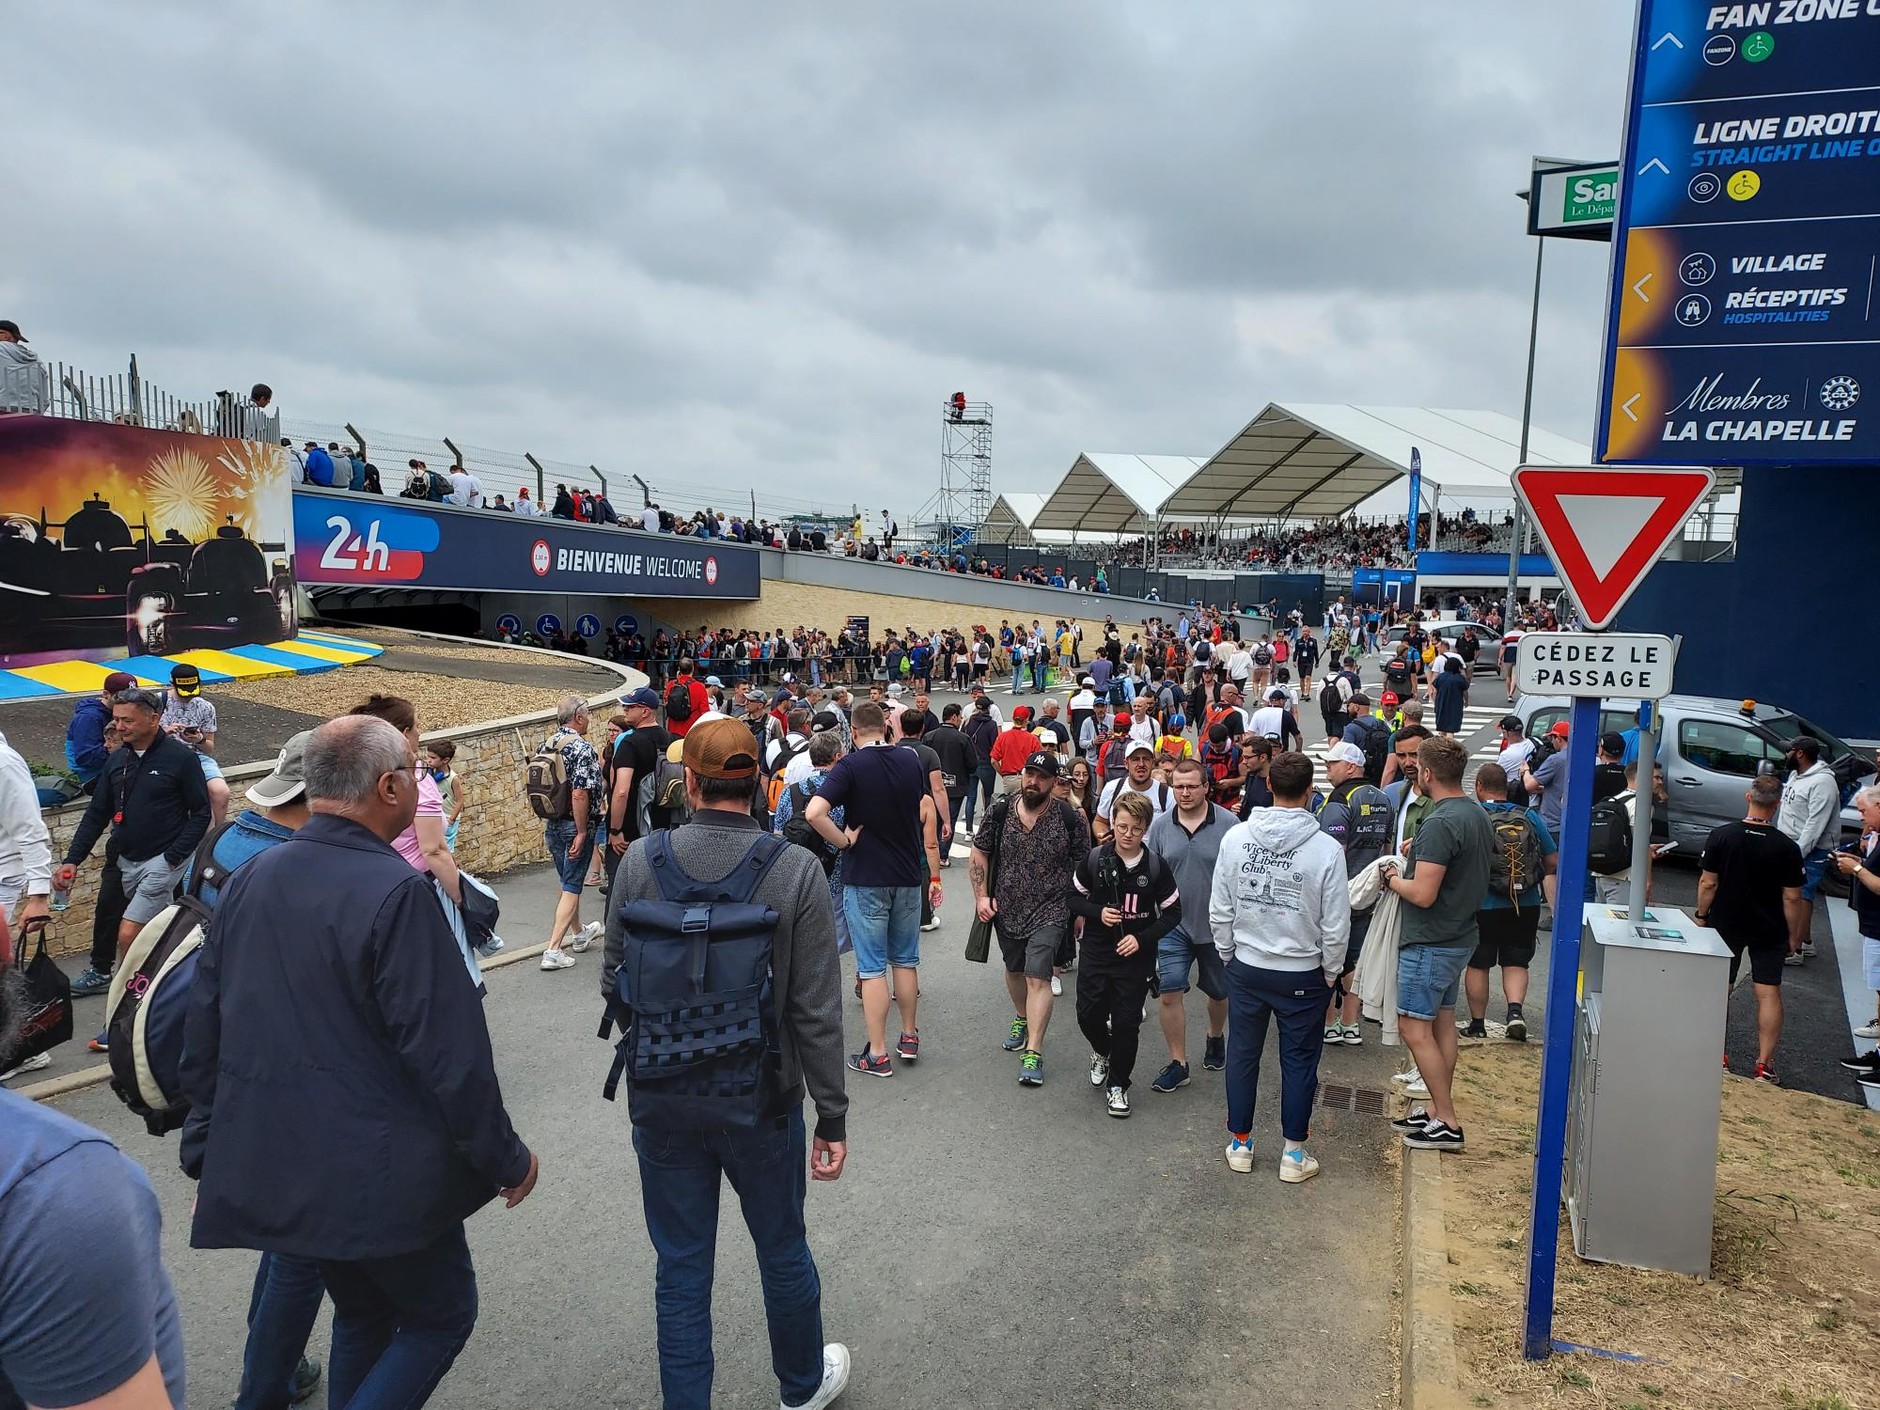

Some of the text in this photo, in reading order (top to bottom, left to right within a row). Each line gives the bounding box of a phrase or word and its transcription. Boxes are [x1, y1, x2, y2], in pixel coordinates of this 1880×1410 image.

[1706, 2, 1771, 31] FAN
[1773, 0, 1860, 24] ZONE
[1693, 117, 1781, 145] LIGNE
[1690, 143, 1808, 167] STRAIGHT
[1809, 139, 1865, 160] LINE
[1572, 206, 1584, 216] Le
[1731, 253, 1826, 274] VILLAGE
[1725, 286, 1848, 309] RÉCEPTIFS
[1723, 310, 1830, 325] HOSPITALITIES
[1664, 372, 1790, 416] Membres
[1662, 419, 1856, 441] LA CHAPELLE
[320, 515, 390, 571] 24h
[557, 548, 702, 579] BIENVENUE WELCOME
[1533, 641, 1658, 664] CÉDEZ LE
[1537, 669, 1652, 688] PASSAGE
[1242, 842, 1269, 855] Vice
[1241, 862, 1266, 874] Club
[1248, 853, 1293, 871] Liberty
